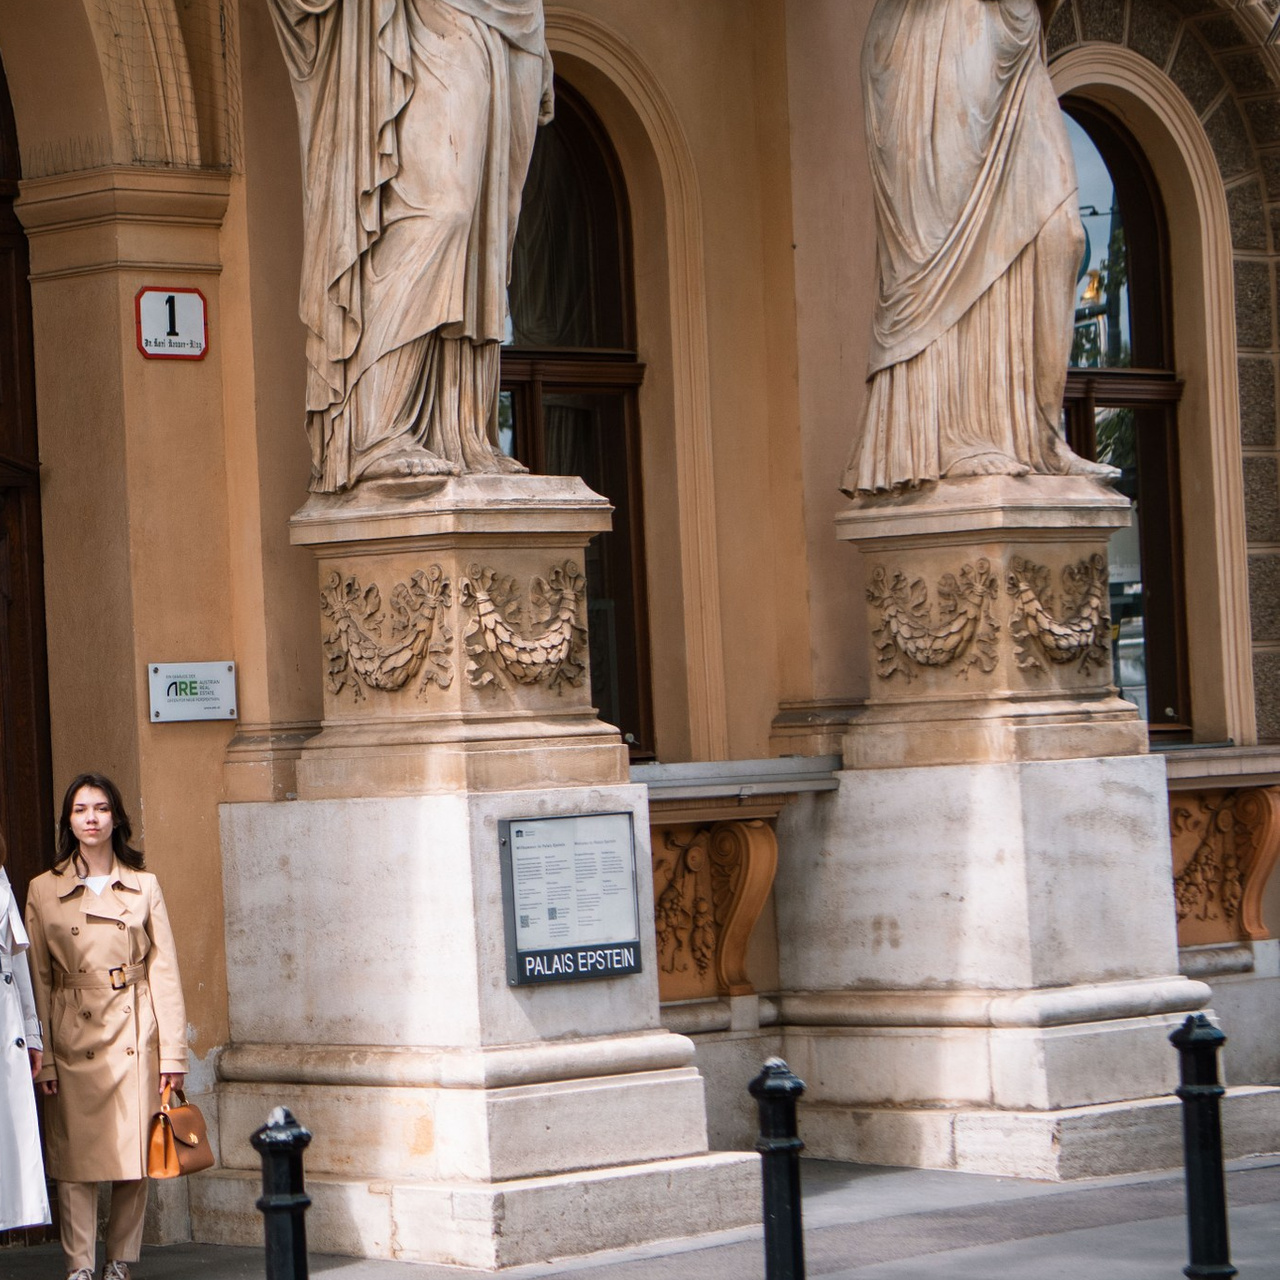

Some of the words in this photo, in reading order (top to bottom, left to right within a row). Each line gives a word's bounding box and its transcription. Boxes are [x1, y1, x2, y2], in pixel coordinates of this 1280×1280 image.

[165, 295, 179, 336] 1
[167, 680, 198, 697] ARE
[526, 952, 574, 976] PALAIS
[578, 948, 634, 971] EPSTEIN
